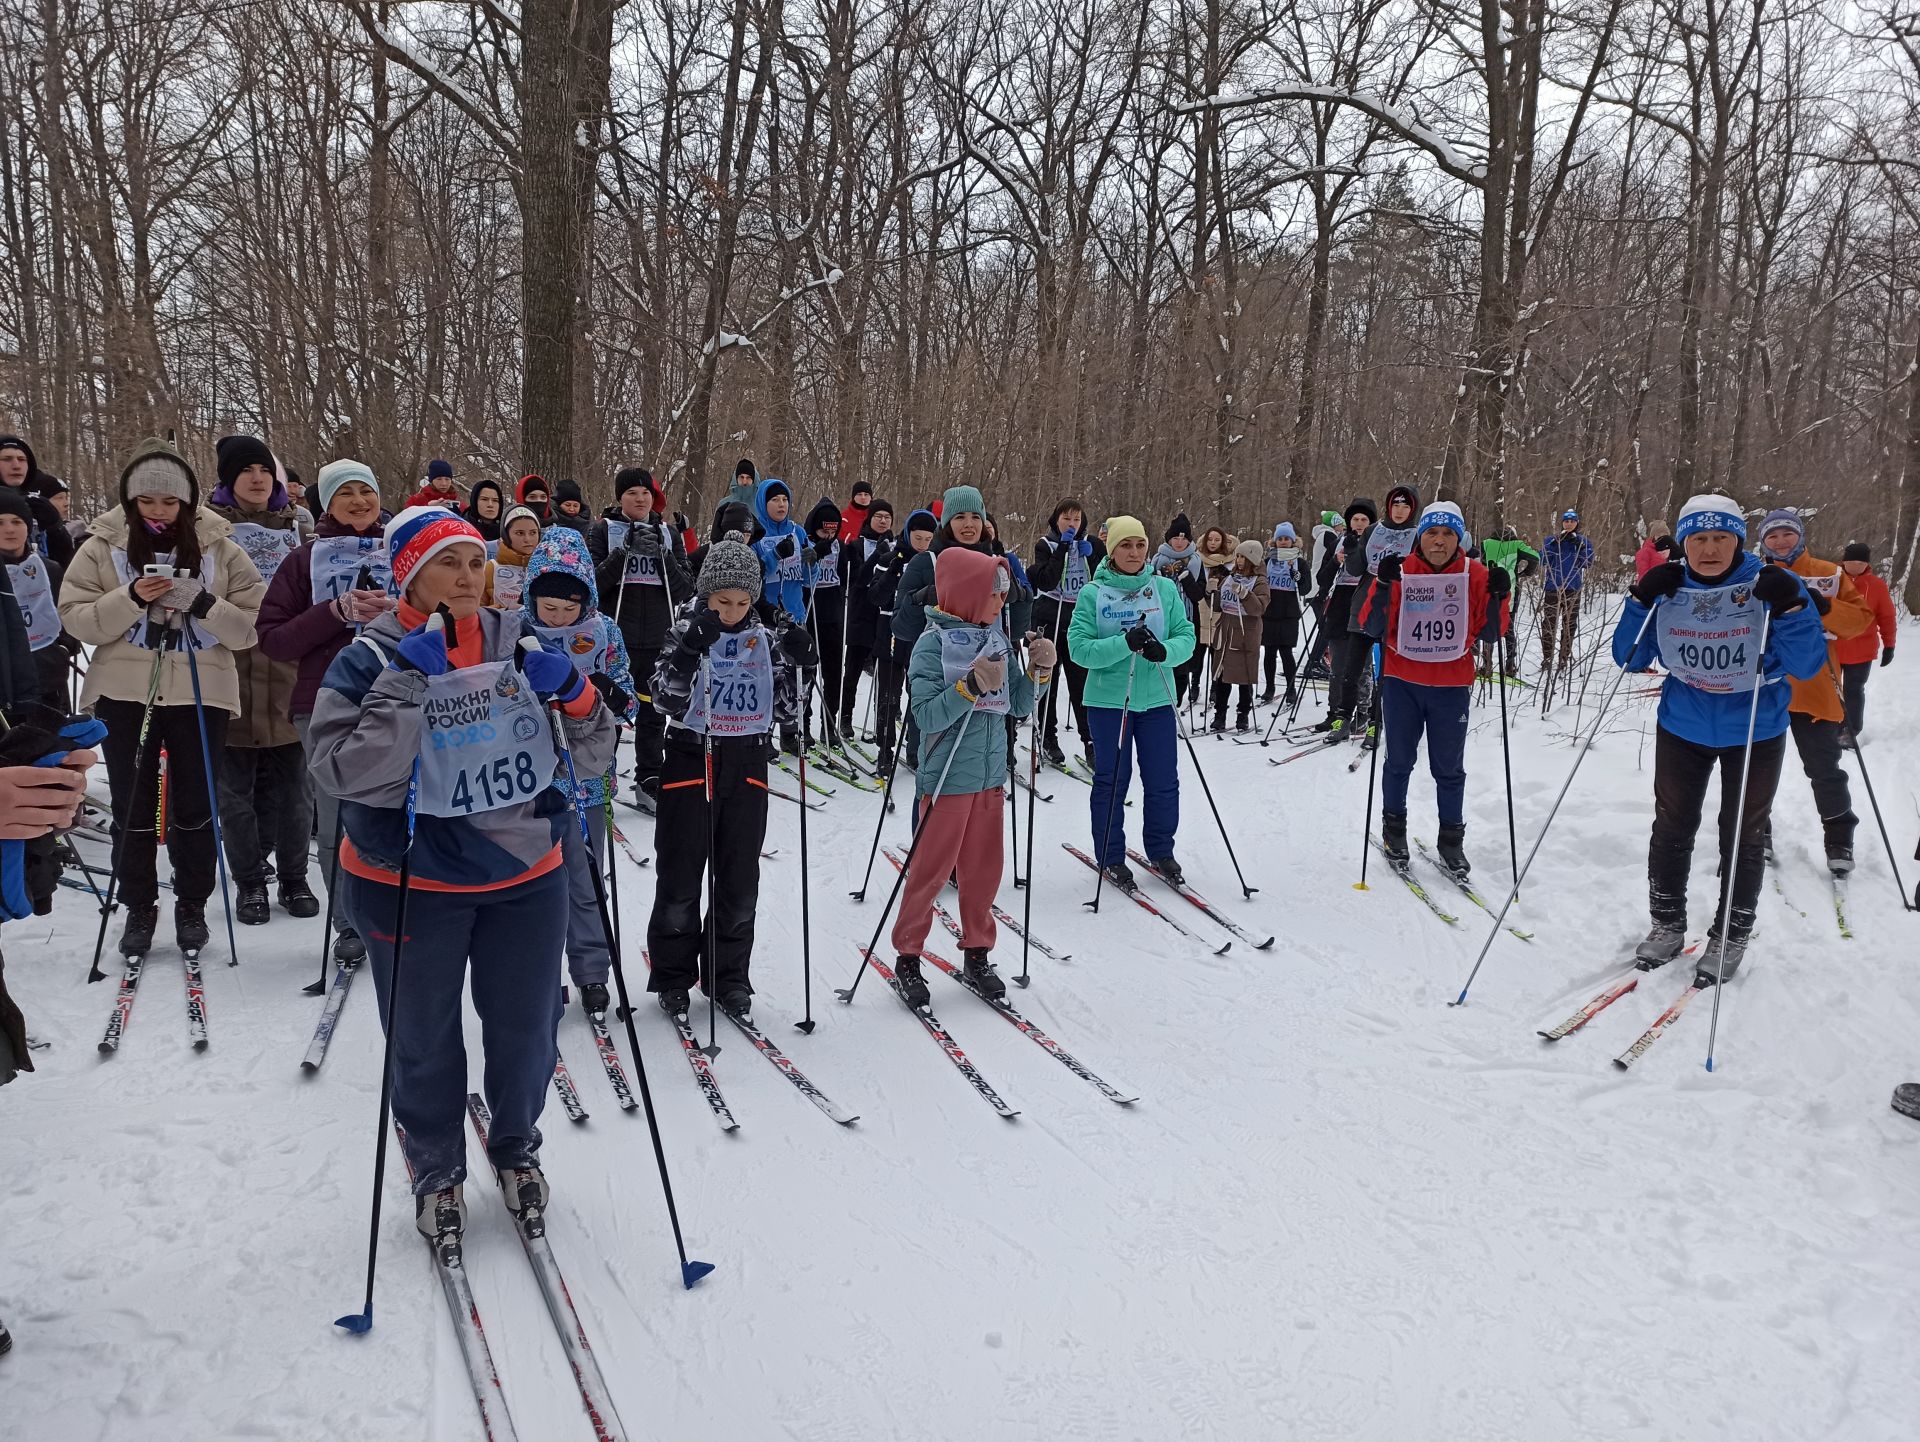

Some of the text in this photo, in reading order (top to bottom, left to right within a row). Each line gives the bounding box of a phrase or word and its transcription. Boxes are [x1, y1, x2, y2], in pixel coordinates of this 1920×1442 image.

[254, 562, 279, 570] ОССИИ
[1406, 587, 1434, 595] ЛЫЖНЯ
[1406, 594, 1434, 602] РОССИИ
[1412, 619, 1455, 642] 4199
[1669, 627, 1698, 638] ЛЫЖНЯ
[1698, 630, 1729, 640] РОССИИ
[1678, 642, 1746, 671] 19004
[423, 689, 491, 714] ЛЫЖНЯ
[710, 679, 758, 711] 7433
[426, 705, 490, 730] РОССИИ
[431, 722, 497, 751] 2020
[451, 751, 537, 813] 4158
[407, 781, 416, 813] STC
